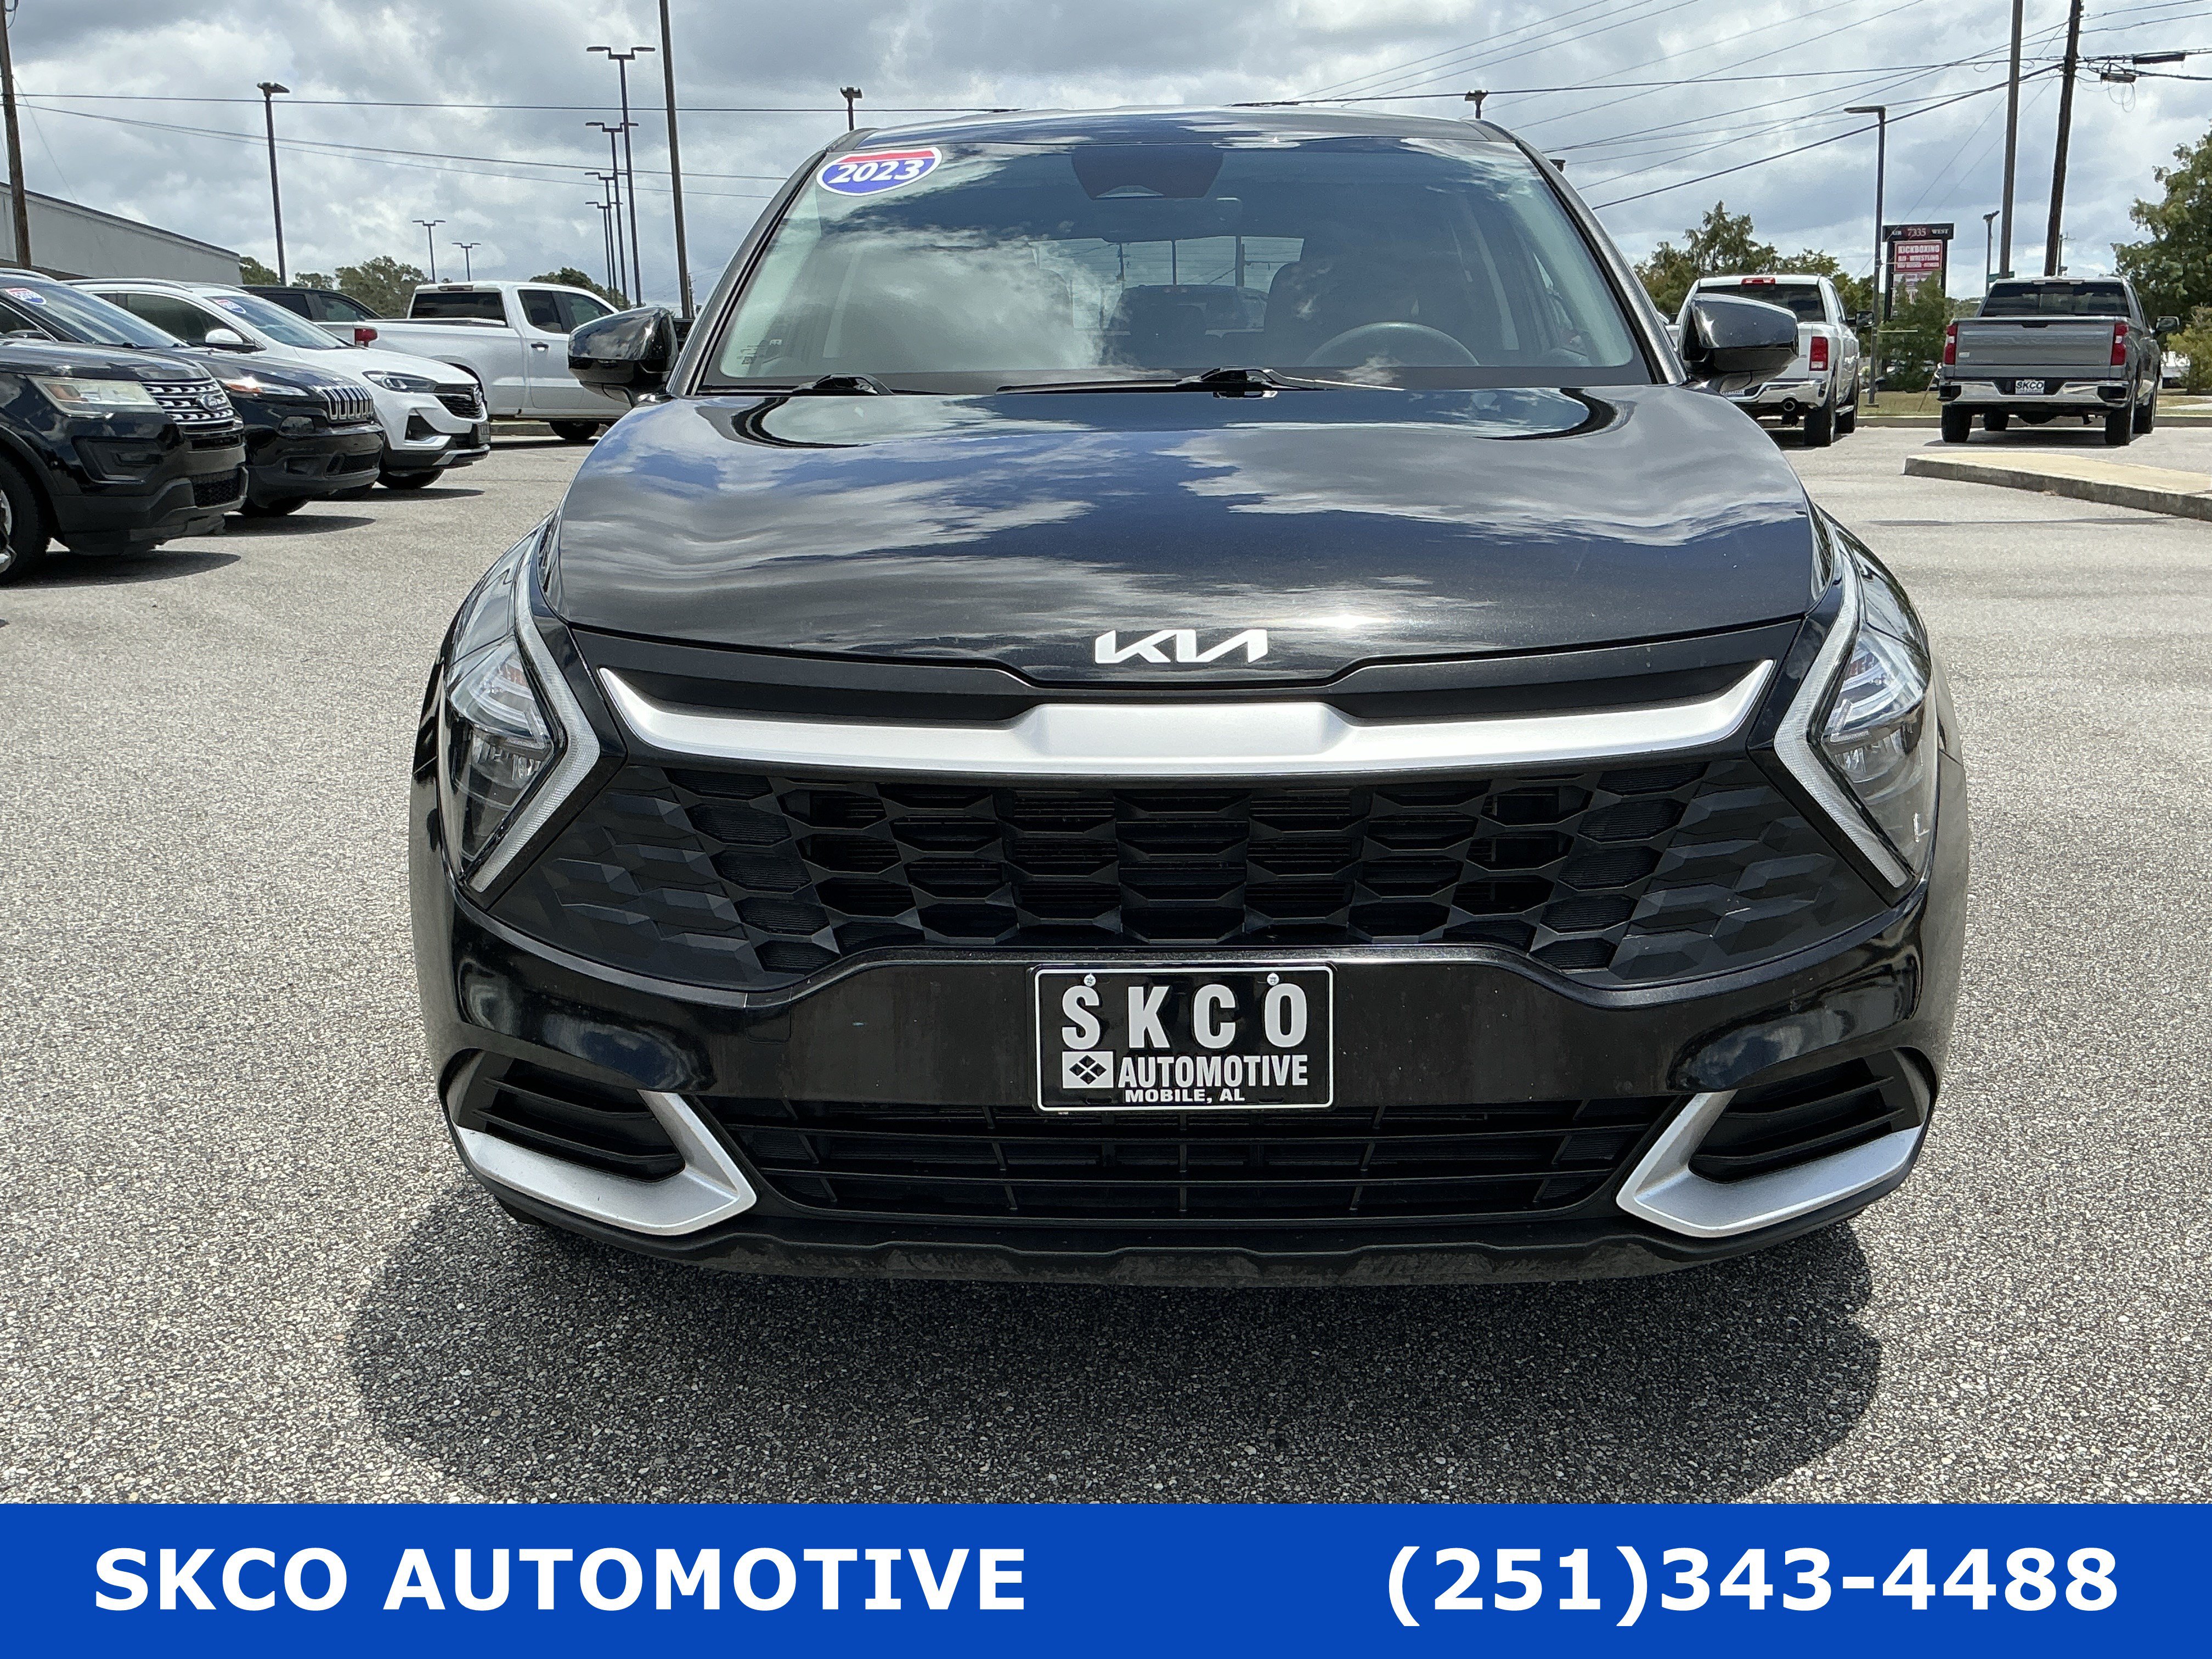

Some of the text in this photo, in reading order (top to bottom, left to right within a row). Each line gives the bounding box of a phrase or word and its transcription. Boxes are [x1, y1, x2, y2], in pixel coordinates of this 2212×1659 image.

[827, 158, 925, 184] 2023
[1908, 228, 1926, 236] 7335
[1898, 245, 1940, 253] KICKBOXING
[2016, 381, 2044, 390] SKCO
[1095, 629, 1268, 664] KIA
[1062, 983, 1307, 1049] SKCO
[1118, 1054, 1308, 1088] AUTOMOTIVE
[1125, 1088, 1245, 1103] MOBILE, AL
